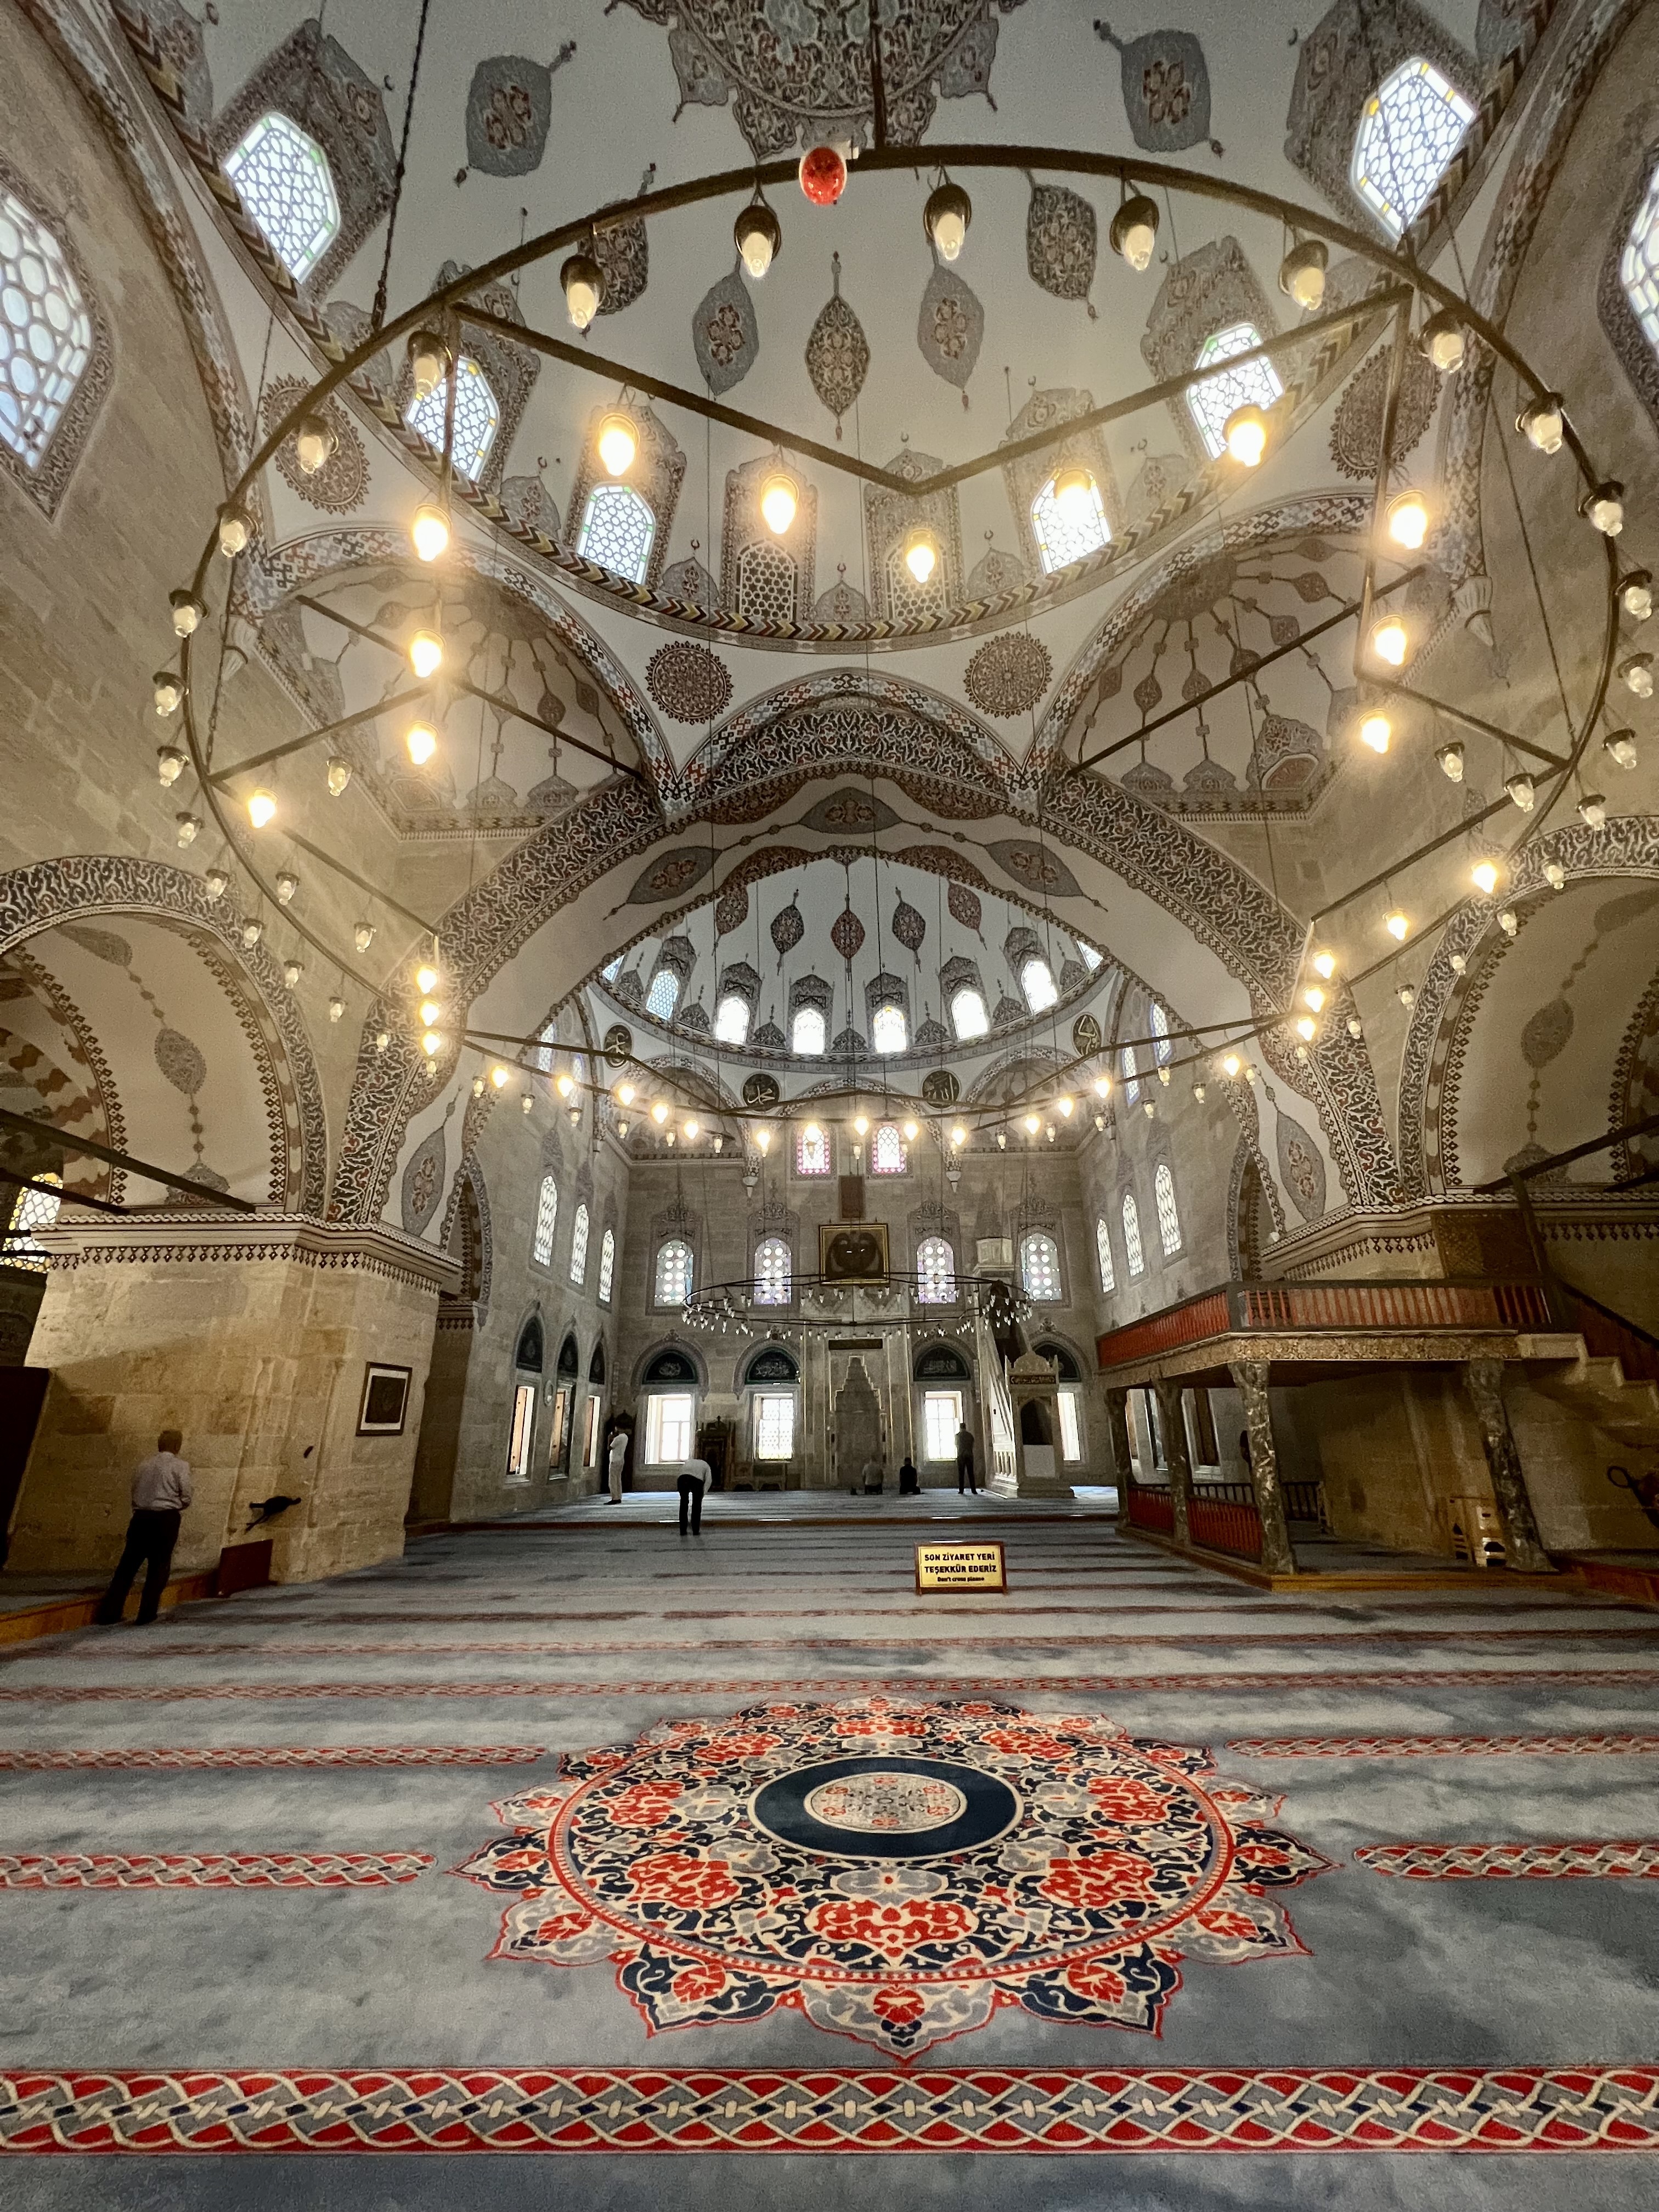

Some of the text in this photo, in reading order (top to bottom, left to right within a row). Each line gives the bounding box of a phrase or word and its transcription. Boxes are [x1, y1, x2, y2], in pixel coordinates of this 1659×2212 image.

[943, 1552, 975, 1561] ZİYARET
[977, 1551, 995, 1560] YERİ
[924, 1564, 997, 1575] TEŞEKKÜR EDERİZ
